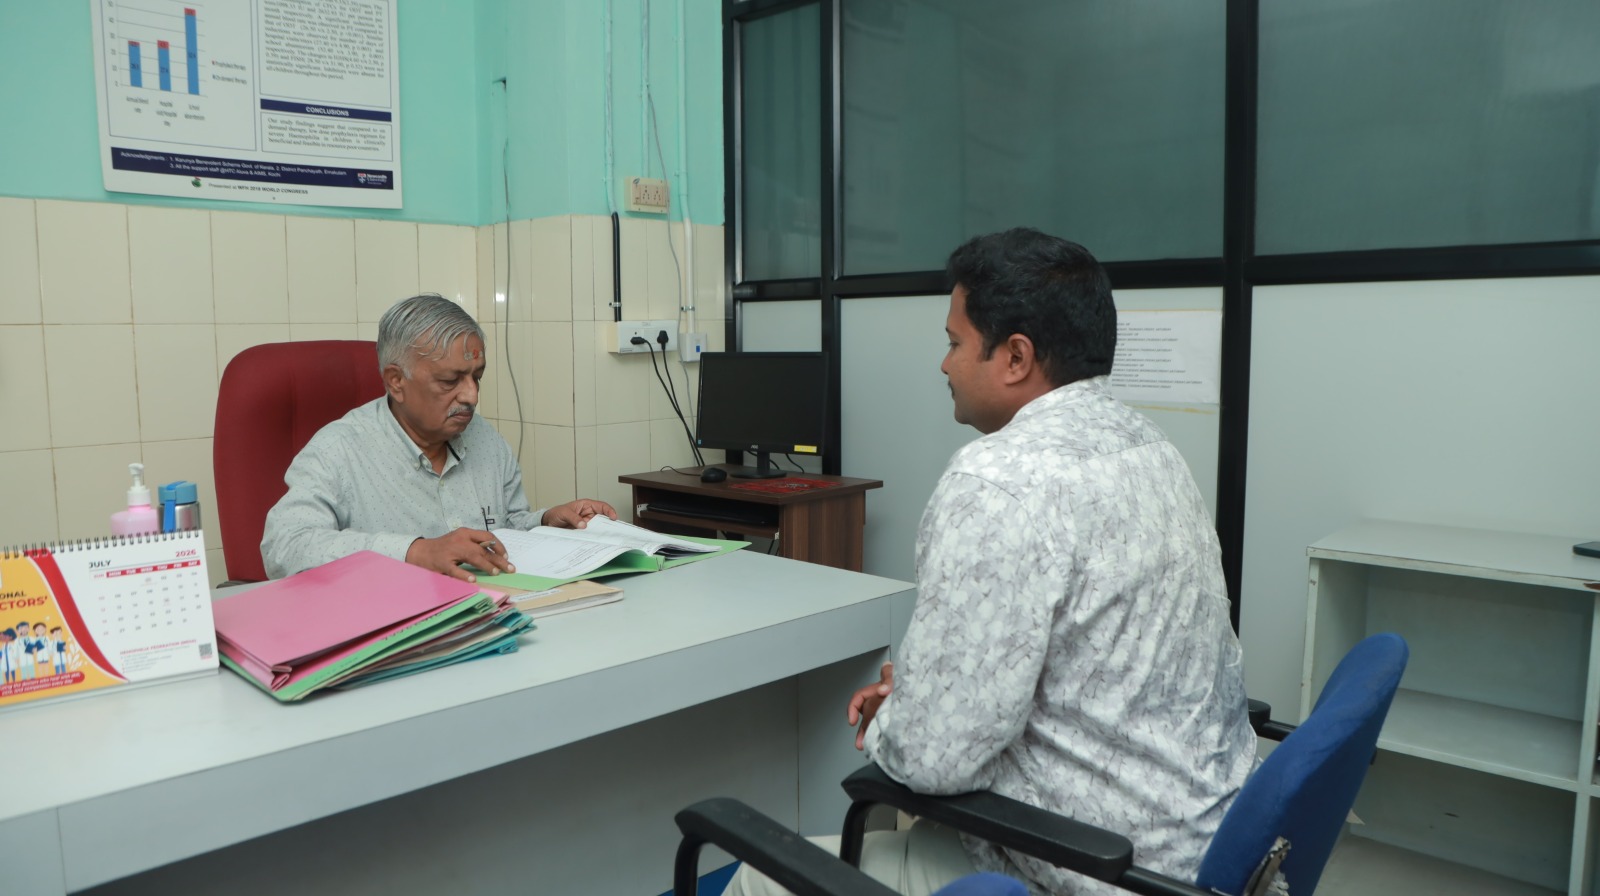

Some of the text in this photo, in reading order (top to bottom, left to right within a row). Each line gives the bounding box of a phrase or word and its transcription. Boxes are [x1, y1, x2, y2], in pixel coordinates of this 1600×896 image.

[306, 107, 349, 116] CONCLUSIONS
[280, 118, 292, 126] study
[295, 120, 314, 128] findings
[348, 125, 370, 133] compared
[288, 132, 319, 140] Haemophilia
[330, 130, 357, 138] prophylaxis
[176, 549, 196, 557] 2026
[89, 560, 111, 568] JULY
